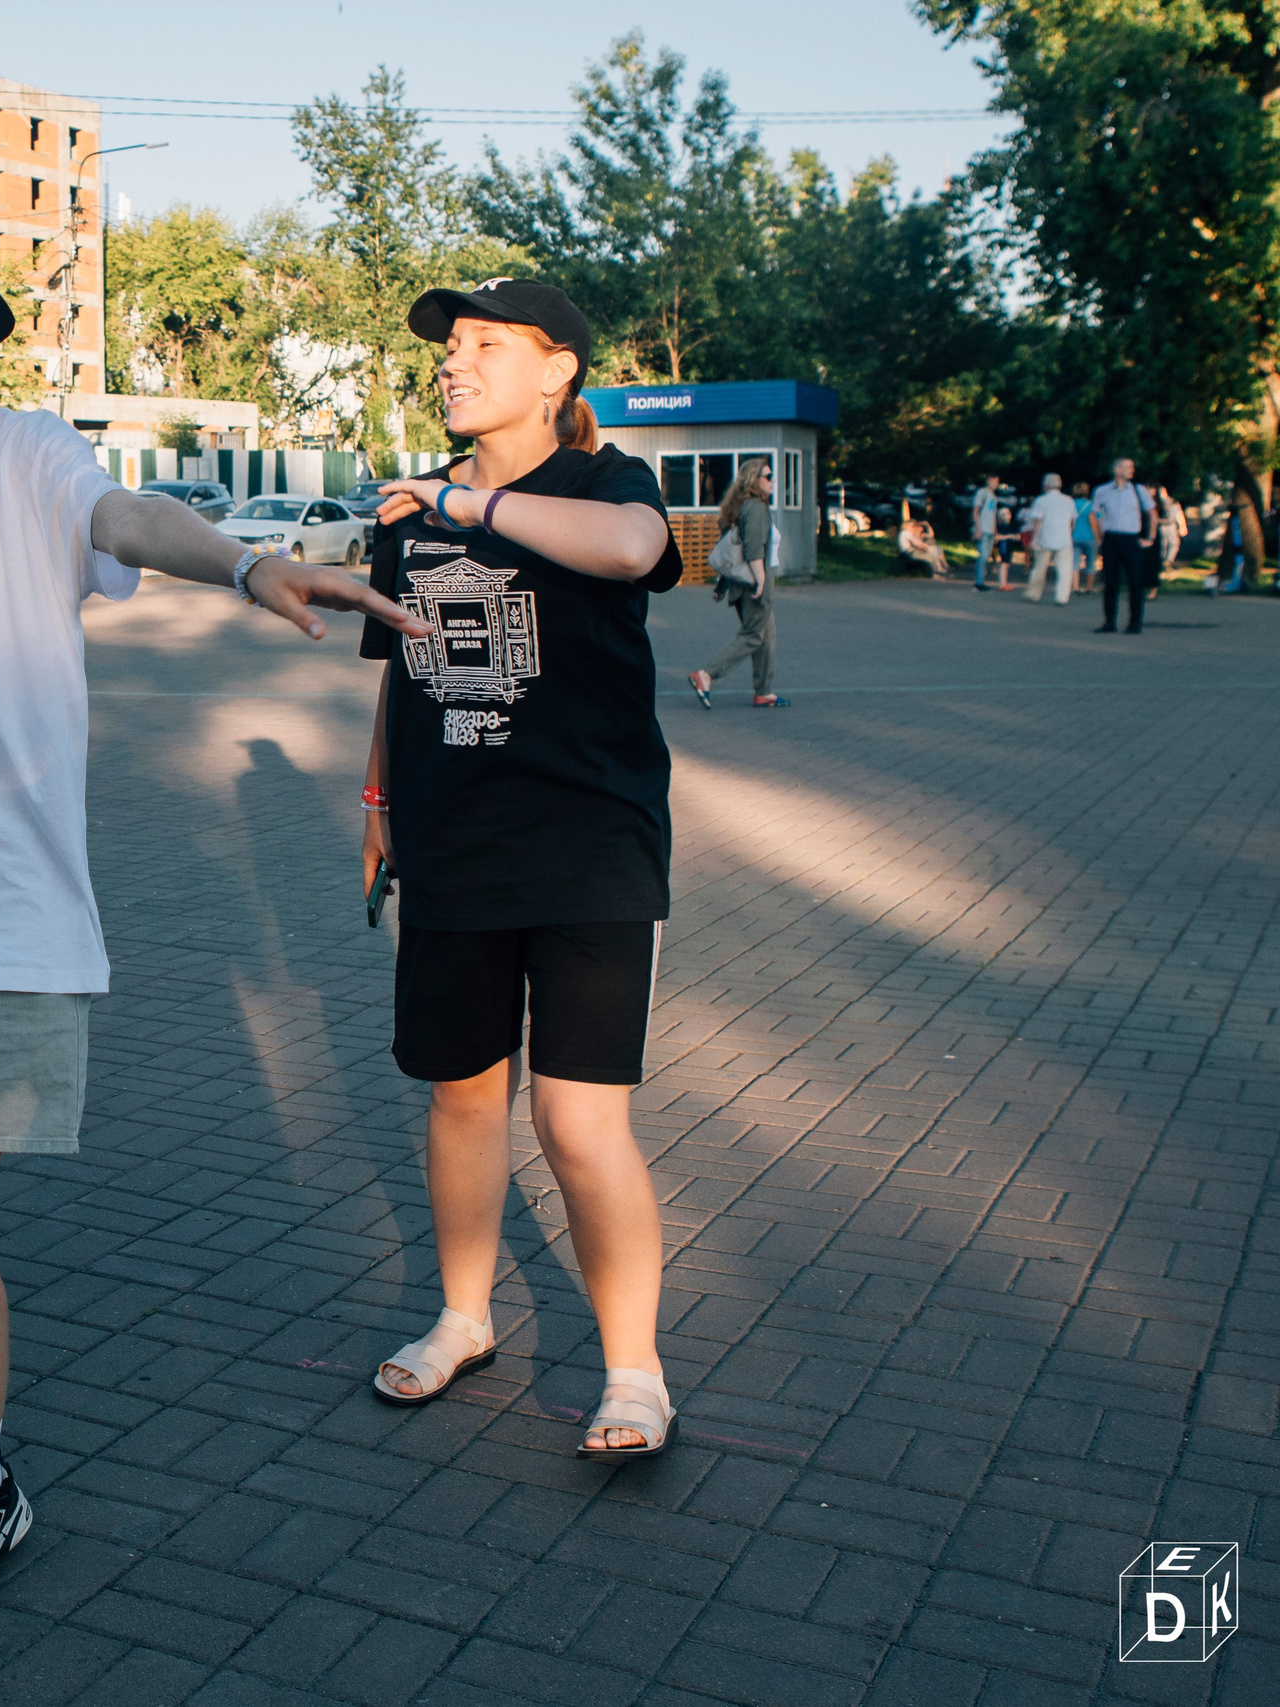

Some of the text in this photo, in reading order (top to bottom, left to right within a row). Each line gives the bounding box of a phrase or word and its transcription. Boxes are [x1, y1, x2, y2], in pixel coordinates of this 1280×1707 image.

[628, 395, 692, 410] ПОЛИЦИЯ
[447, 619, 477, 628] АНГАРА
[443, 629, 489, 638] ОКНО В МИР
[452, 640, 482, 650] ДЖАЗА
